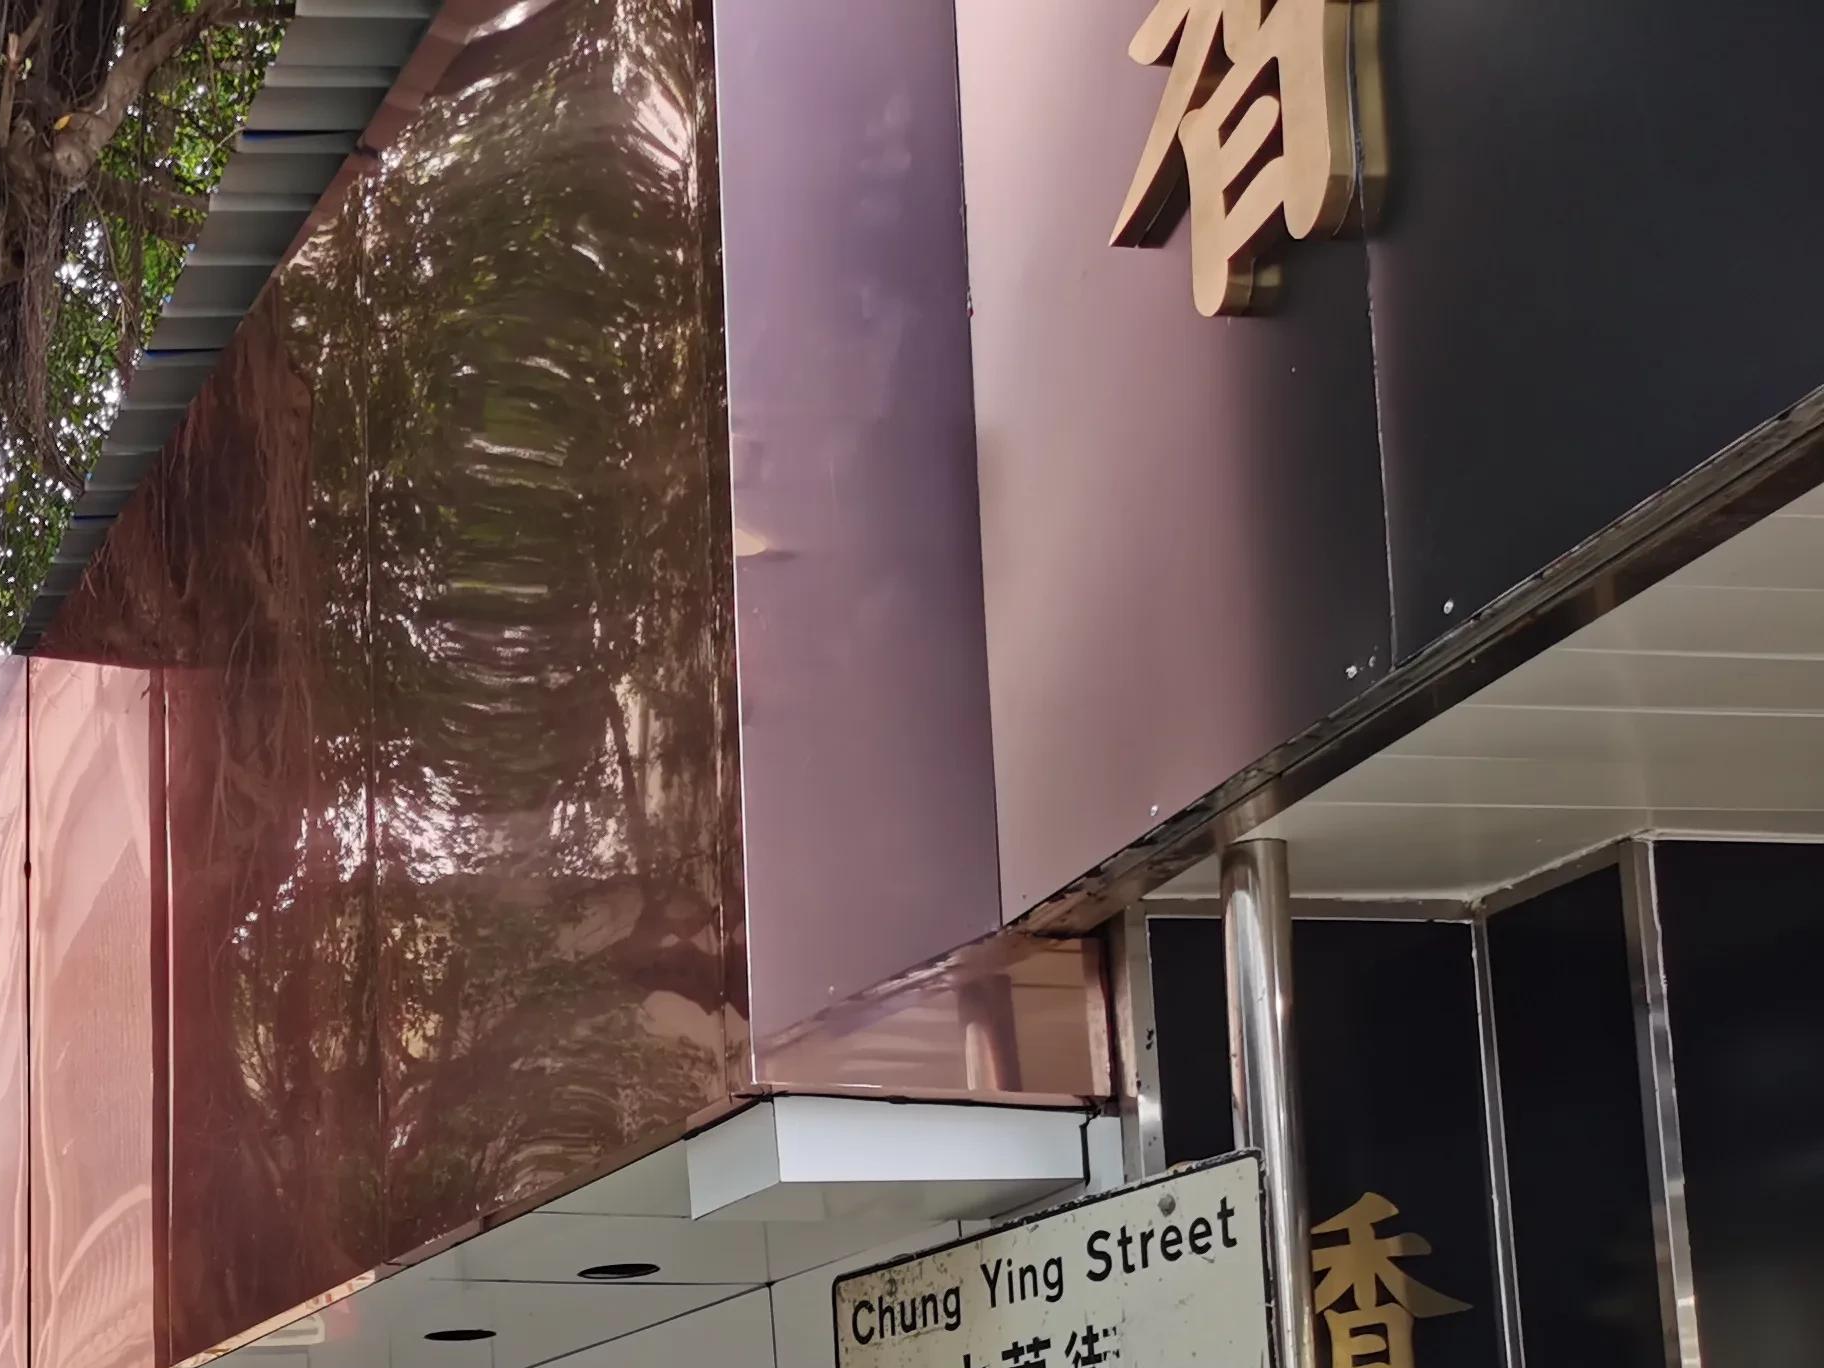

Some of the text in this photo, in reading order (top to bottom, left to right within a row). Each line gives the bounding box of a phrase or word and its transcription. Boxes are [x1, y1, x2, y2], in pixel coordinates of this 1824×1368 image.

[850, 1195, 1238, 1345] Chung Ying Street
